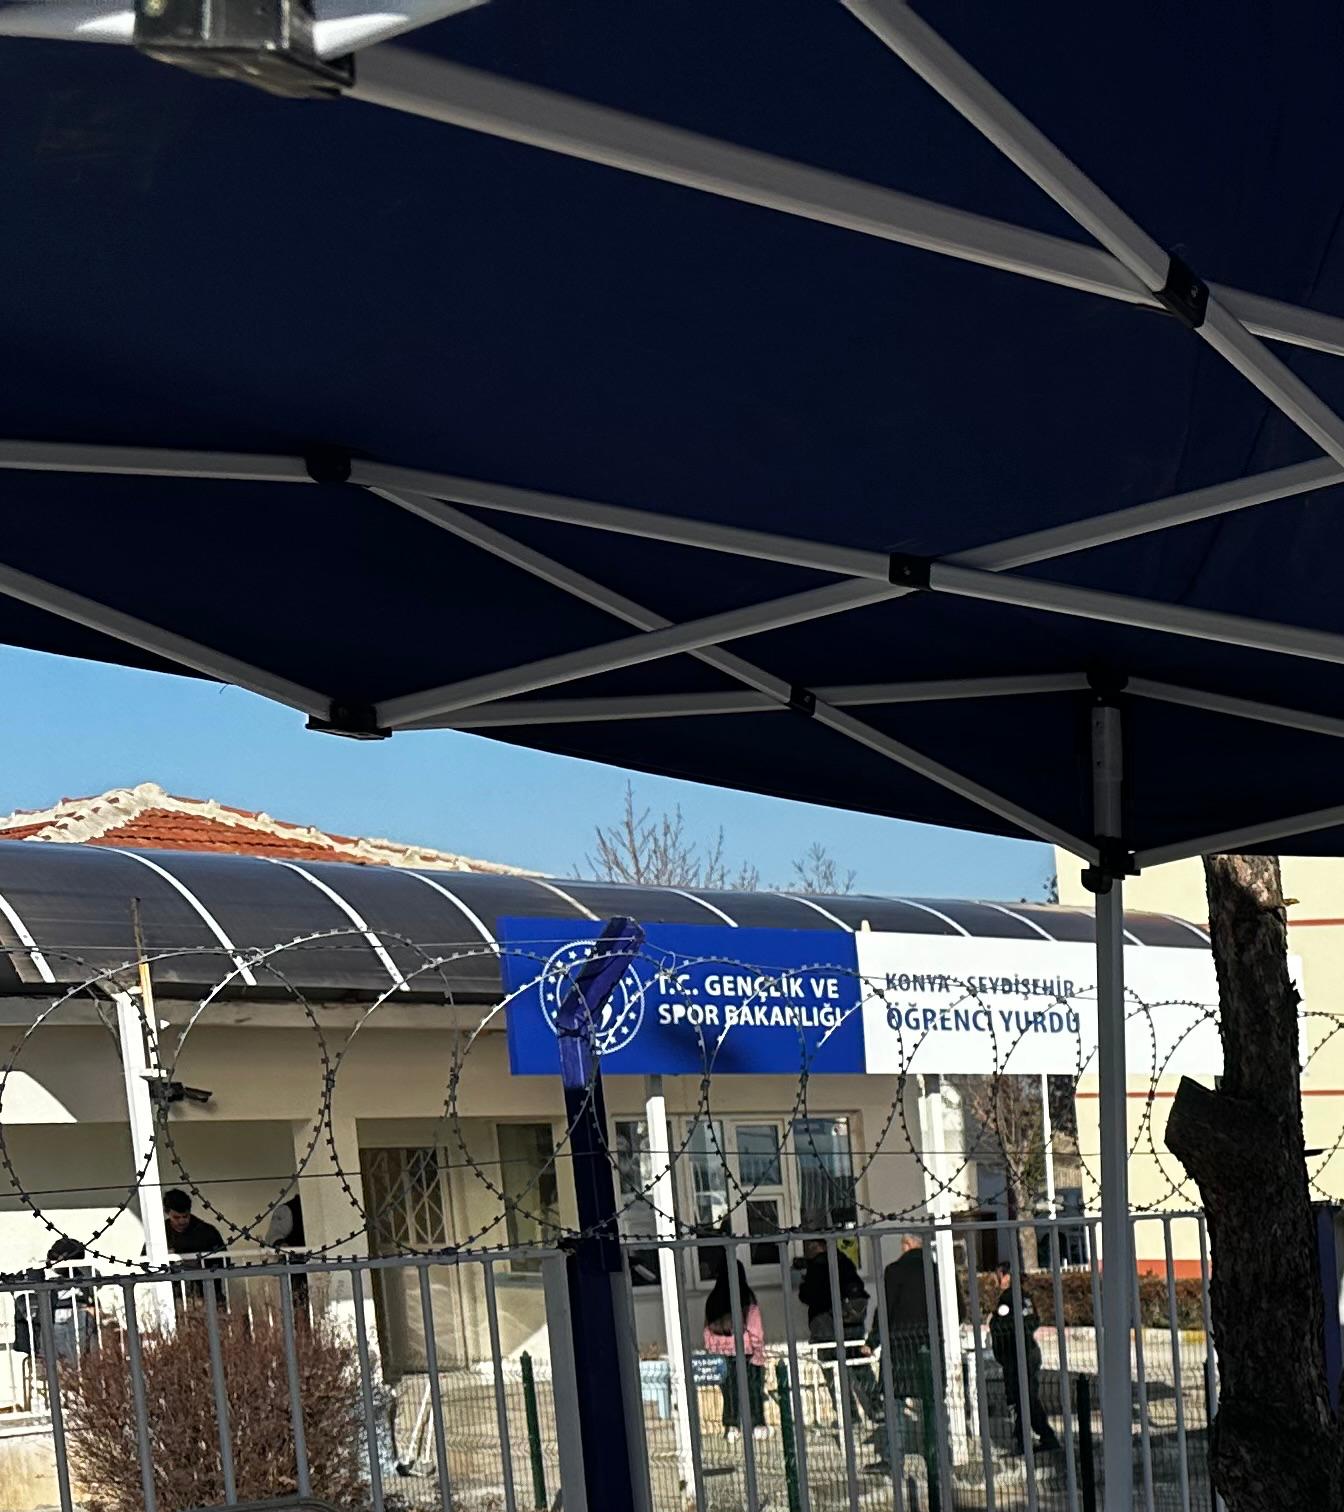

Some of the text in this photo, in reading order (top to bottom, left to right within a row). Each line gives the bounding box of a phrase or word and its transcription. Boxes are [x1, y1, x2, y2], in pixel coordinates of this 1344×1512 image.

[658, 973, 840, 1003] T.C. GENÇLİK VE
[886, 973, 950, 993] KONYA
[658, 1002, 842, 1028] SPOR BAKANLIĞI
[999, 1009, 1080, 1034] YURDU
